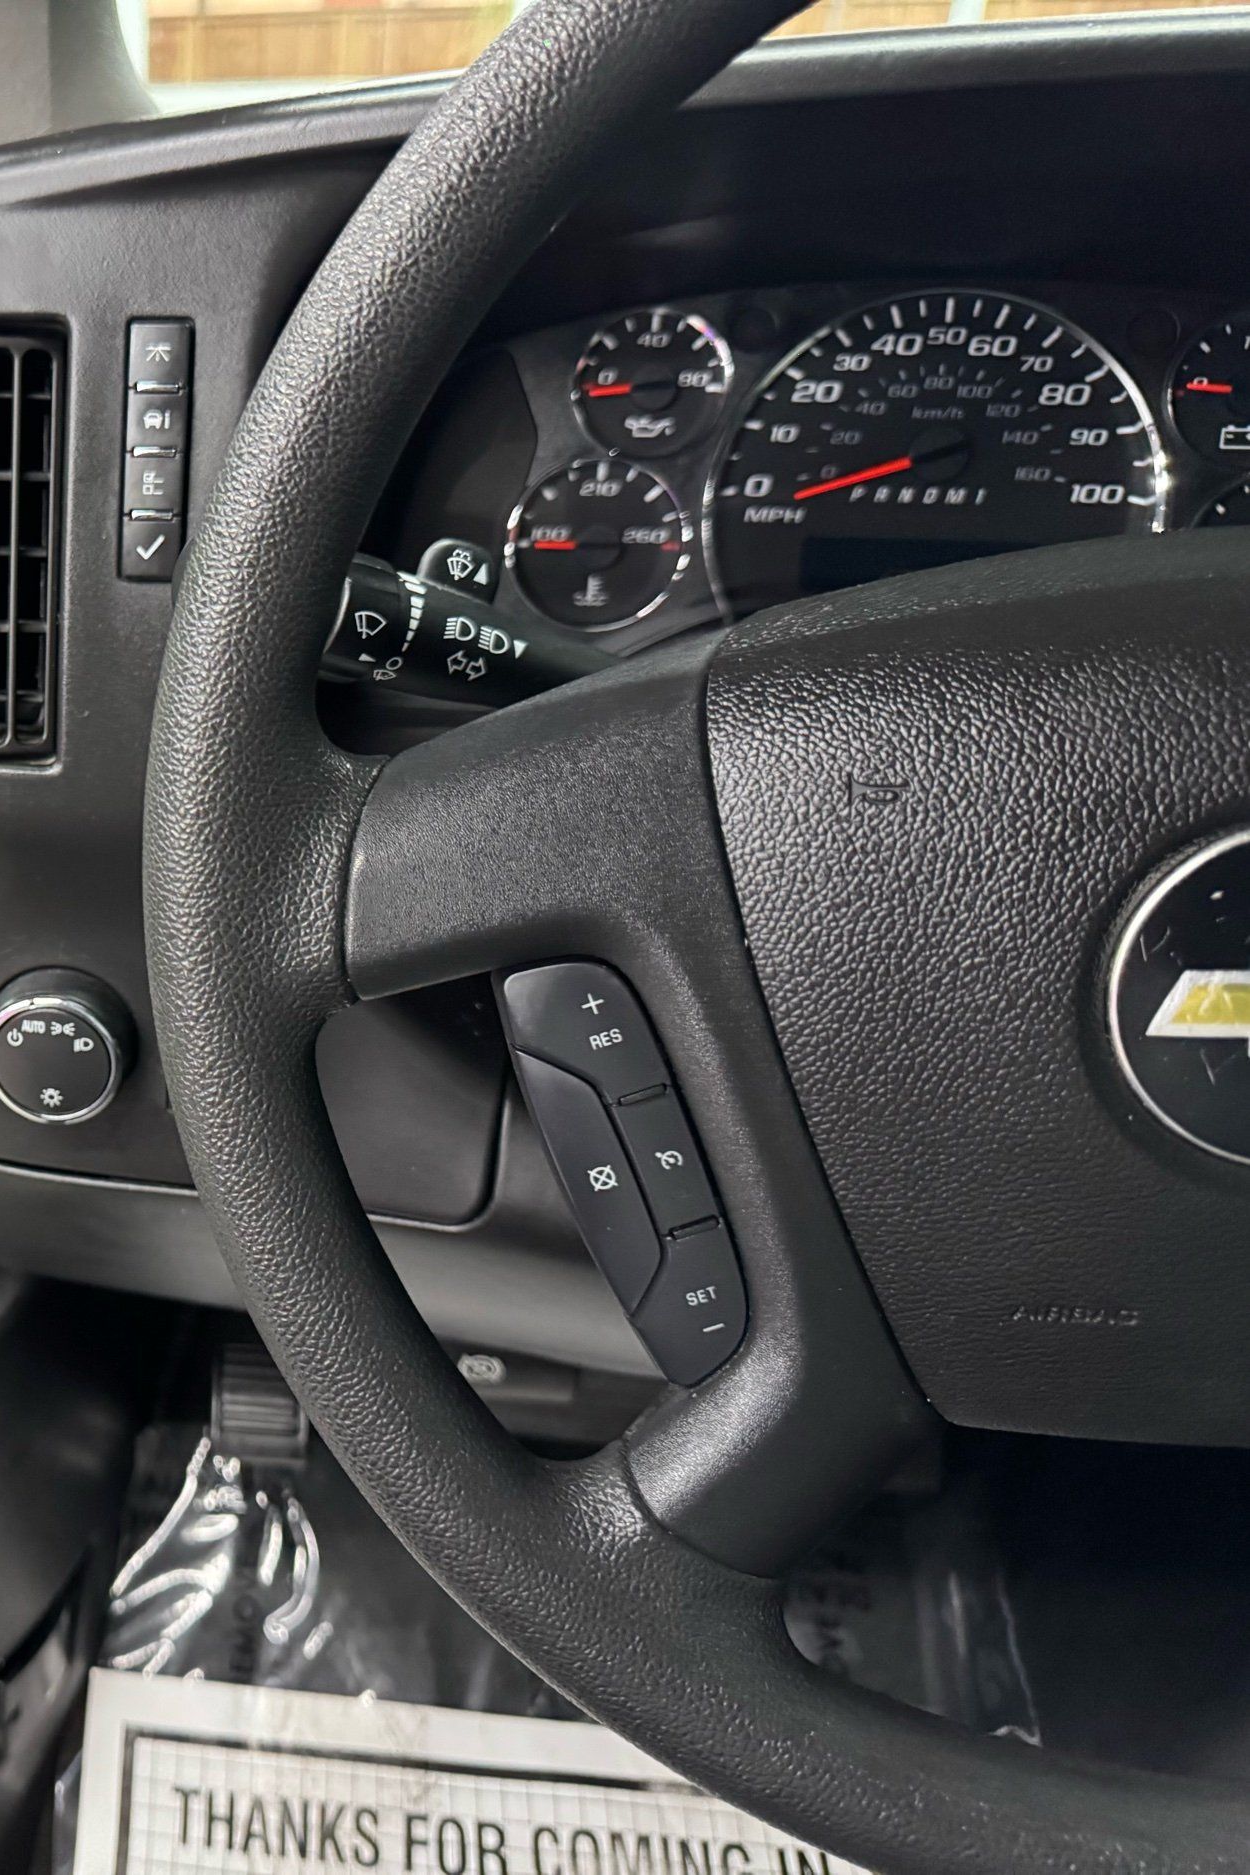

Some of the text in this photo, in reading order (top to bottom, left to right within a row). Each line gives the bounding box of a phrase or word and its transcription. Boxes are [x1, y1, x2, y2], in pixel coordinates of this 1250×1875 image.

[636, 332, 672, 348] 40
[870, 333, 924, 356] 40
[927, 327, 968, 345] 50
[967, 335, 1018, 356] 60
[833, 353, 872, 371] 30
[1020, 356, 1053, 372] 70
[887, 384, 918, 398] 60
[924, 376, 954, 389] 80
[790, 380, 843, 403] 20
[956, 385, 993, 399] 100
[1038, 383, 1092, 406] 80
[855, 401, 887, 415] 40
[911, 406, 965, 419] km/h
[986, 404, 1021, 418] 120
[770, 424, 800, 443] 10
[830, 430, 863, 445] 20
[1002, 430, 1039, 445] 140
[1069, 428, 1109, 446] 90
[1014, 466, 1051, 481] 160
[744, 474, 774, 497] 0
[1070, 484, 1126, 504] 100
[744, 506, 807, 523] MPH
[21, 1020, 46, 1034] AUTO
[589, 1029, 623, 1050] RES
[685, 1286, 717, 1307] SET
[174, 1787, 381, 1867] THANKS
[405, 1813, 508, 1875] FOR
